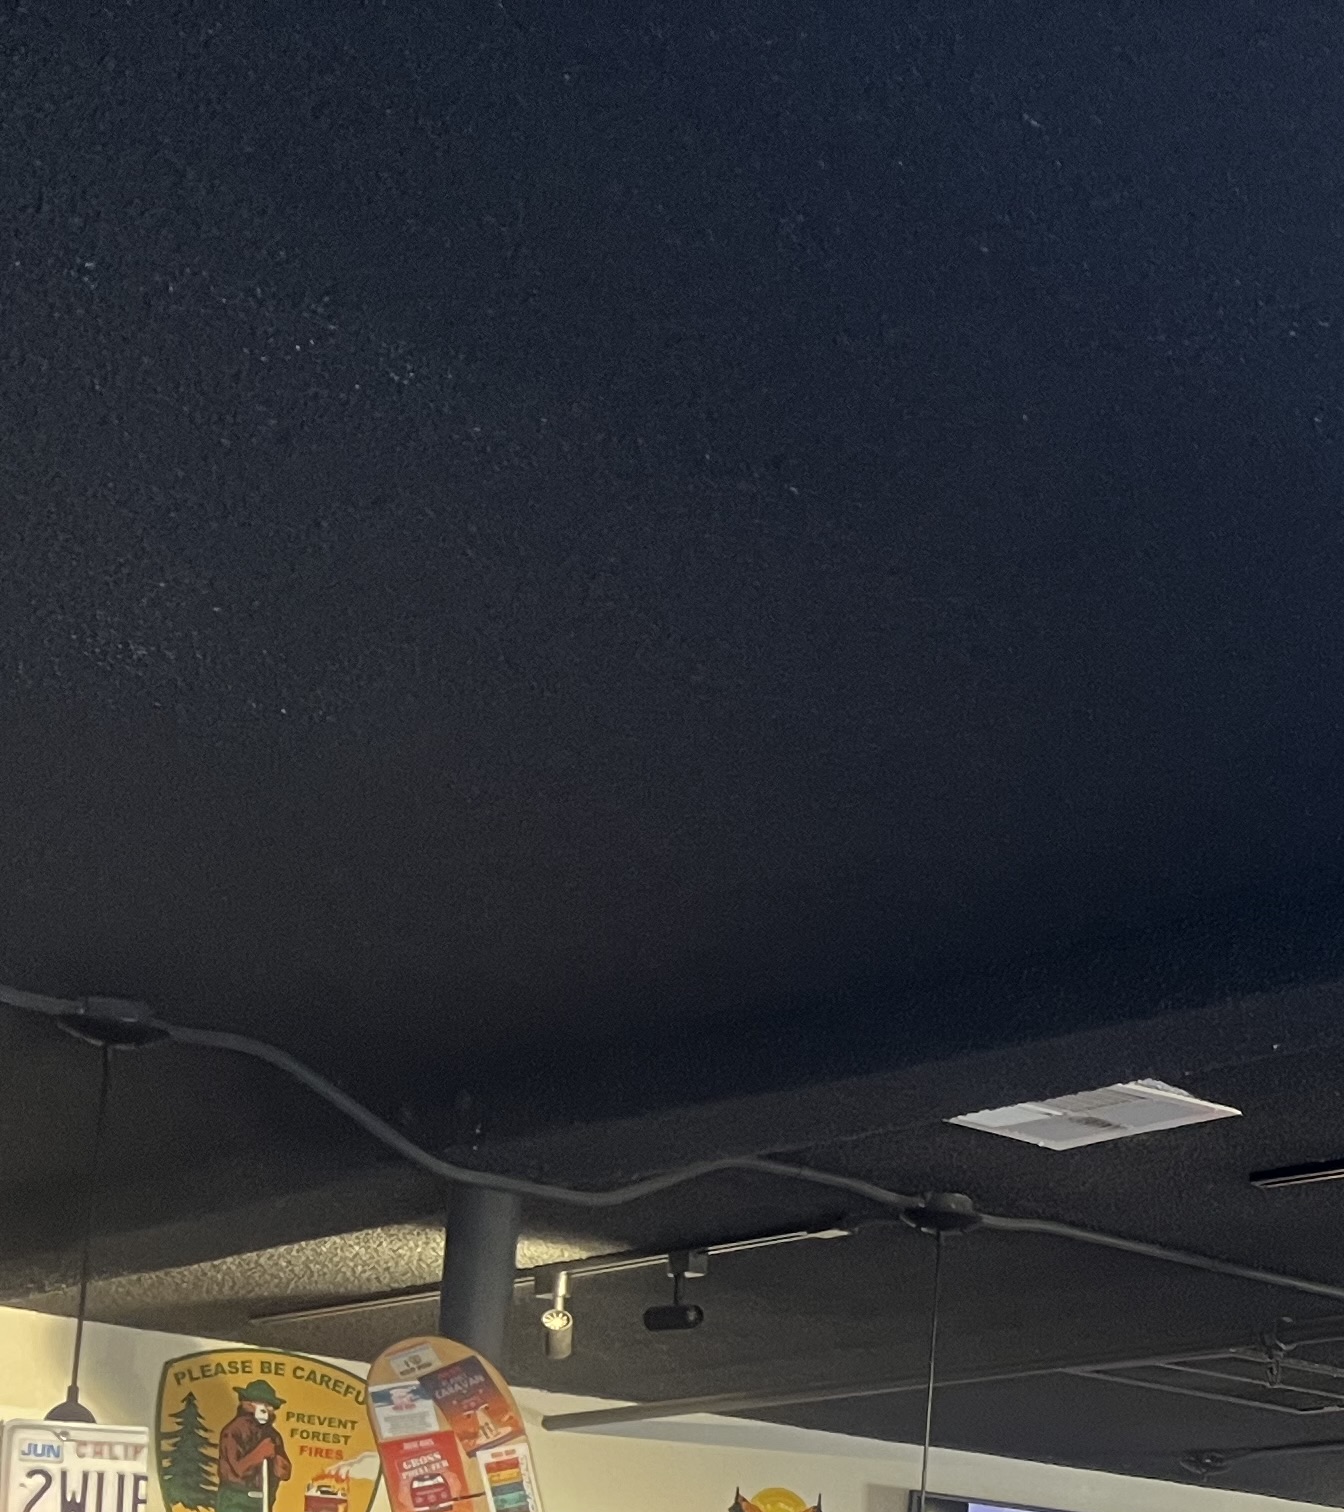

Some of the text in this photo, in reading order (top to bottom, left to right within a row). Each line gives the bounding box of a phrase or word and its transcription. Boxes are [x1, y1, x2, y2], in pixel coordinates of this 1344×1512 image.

[174, 1360, 253, 1386] PLEASE
[260, 1360, 286, 1377] BE
[286, 1411, 359, 1431] PREVENT
[290, 1428, 352, 1446] FOREST
[21, 1442, 61, 1458] JUN
[299, 1444, 345, 1461] FIRES
